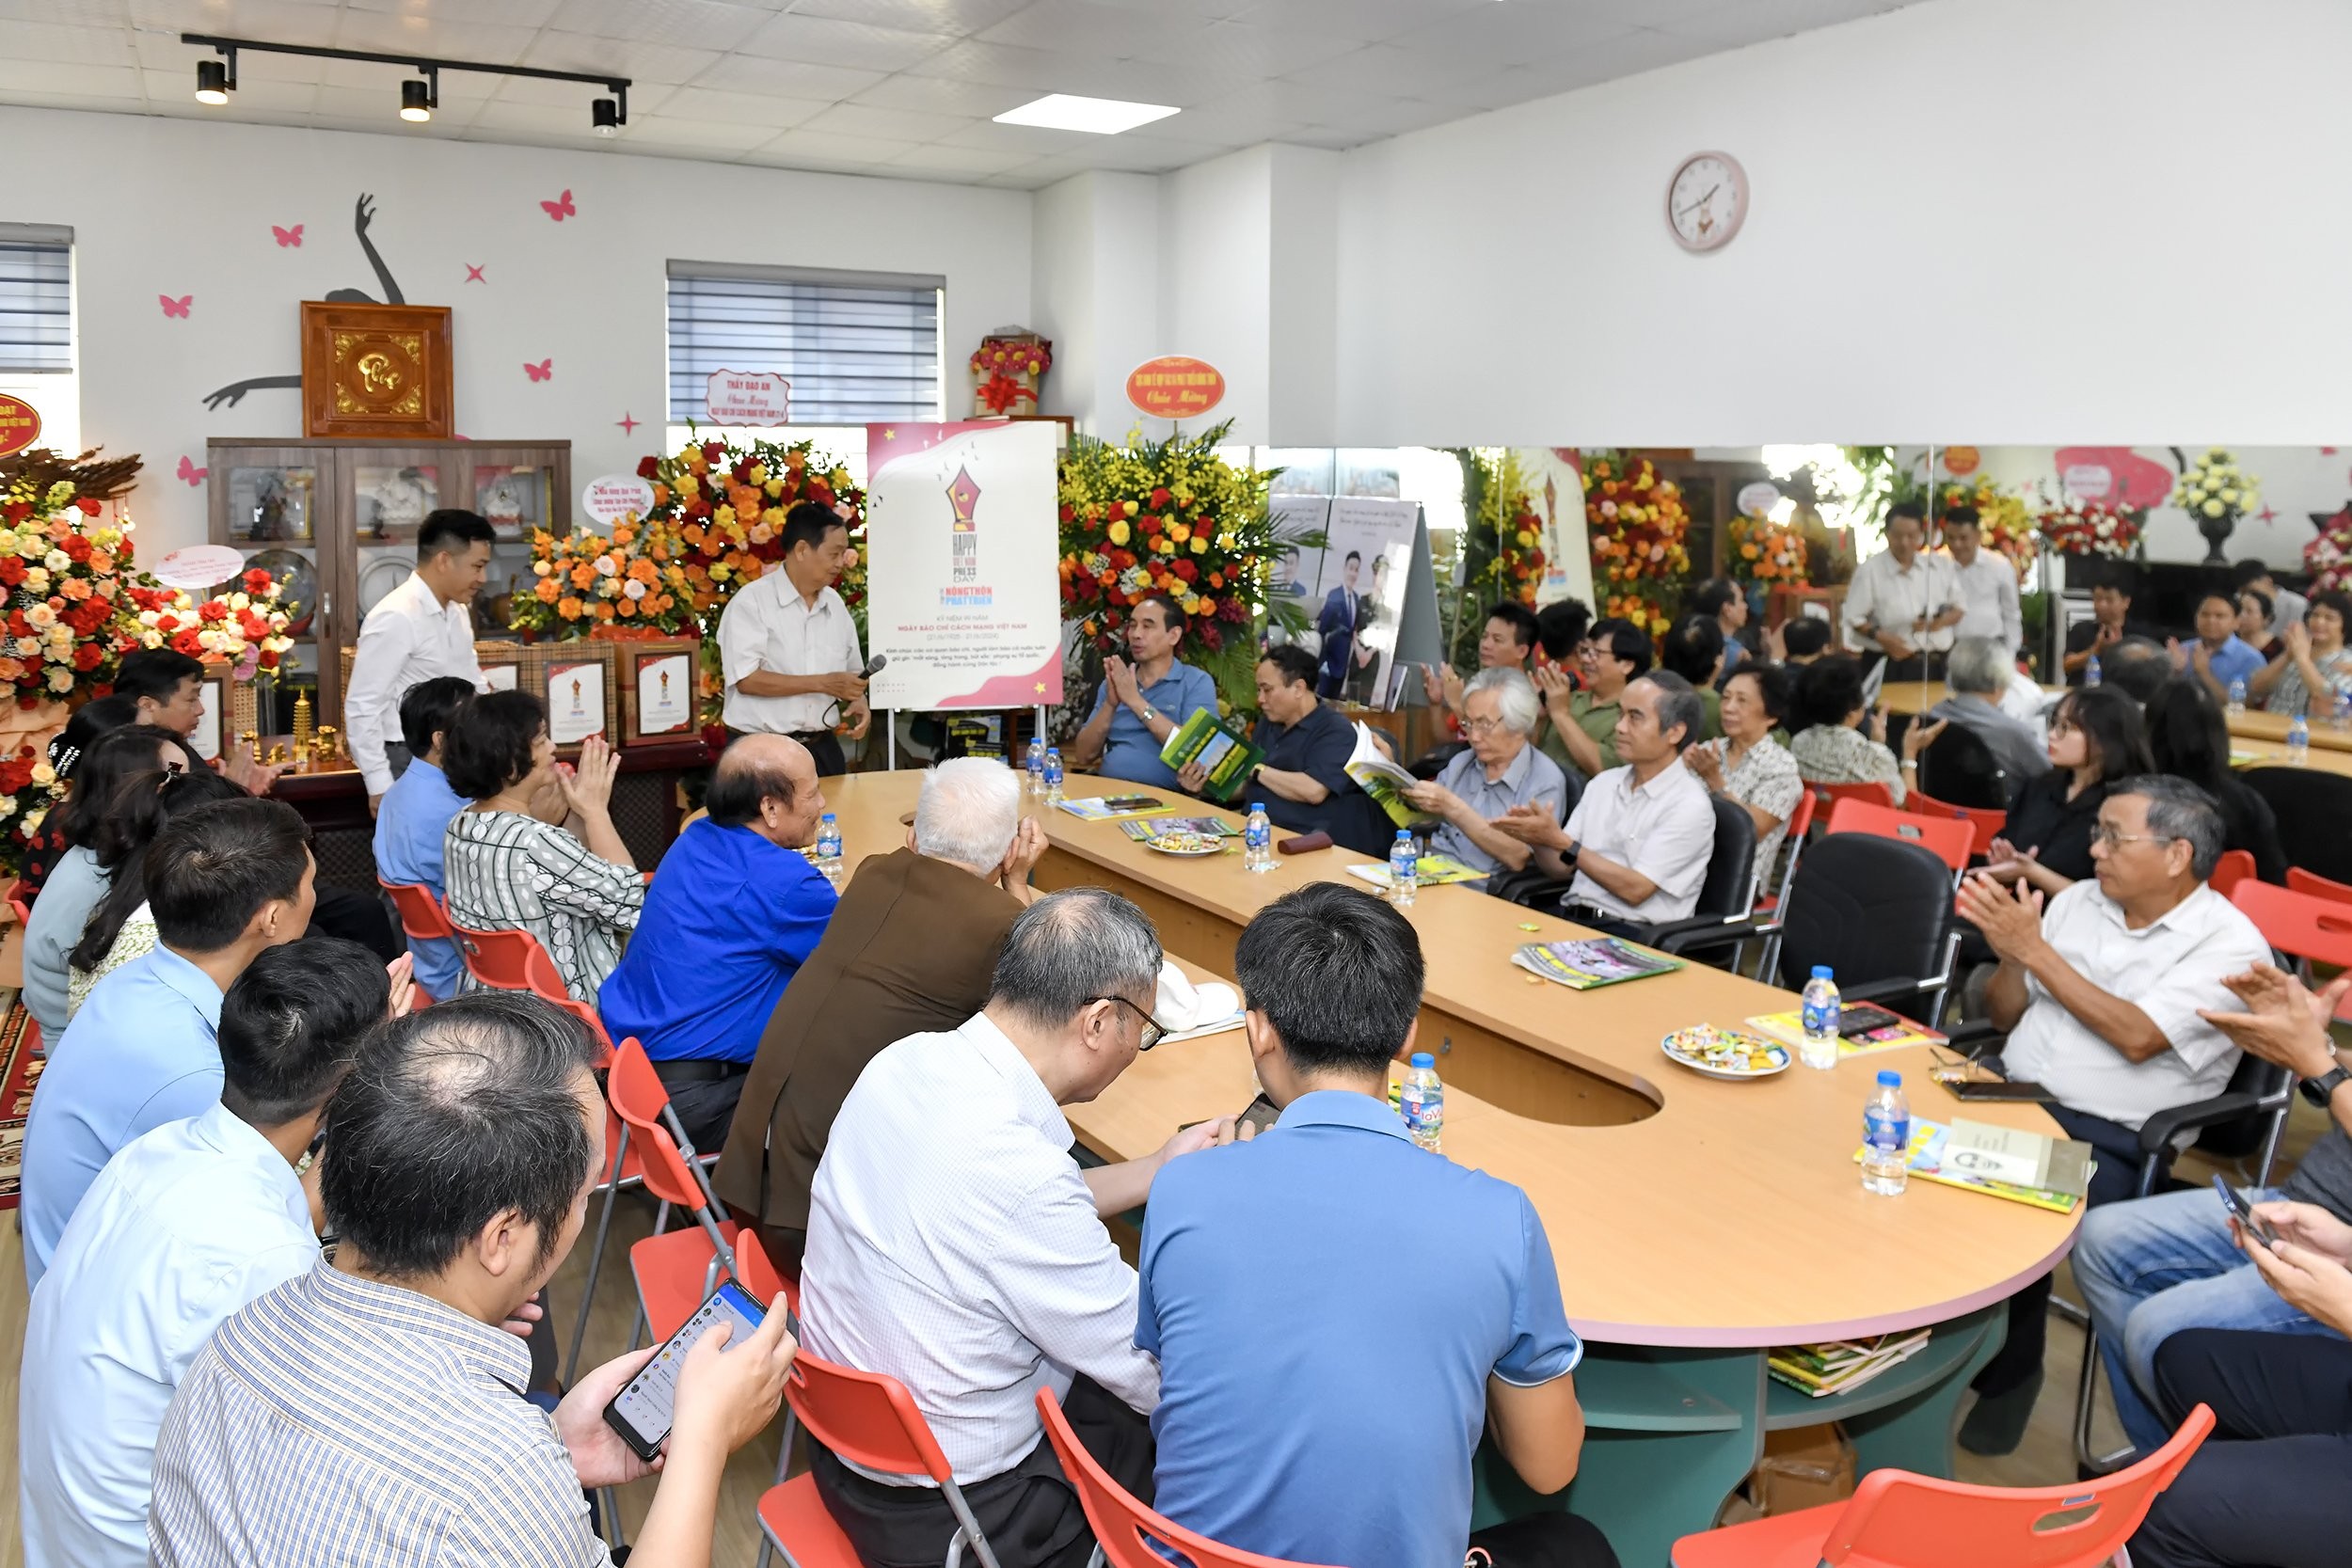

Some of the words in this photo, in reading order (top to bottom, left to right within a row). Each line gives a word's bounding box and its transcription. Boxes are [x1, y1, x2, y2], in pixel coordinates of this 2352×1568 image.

[953, 533, 977, 556] HAPPY
[953, 567, 977, 576] PRESS
[1422, 1108, 1443, 1121] laV
